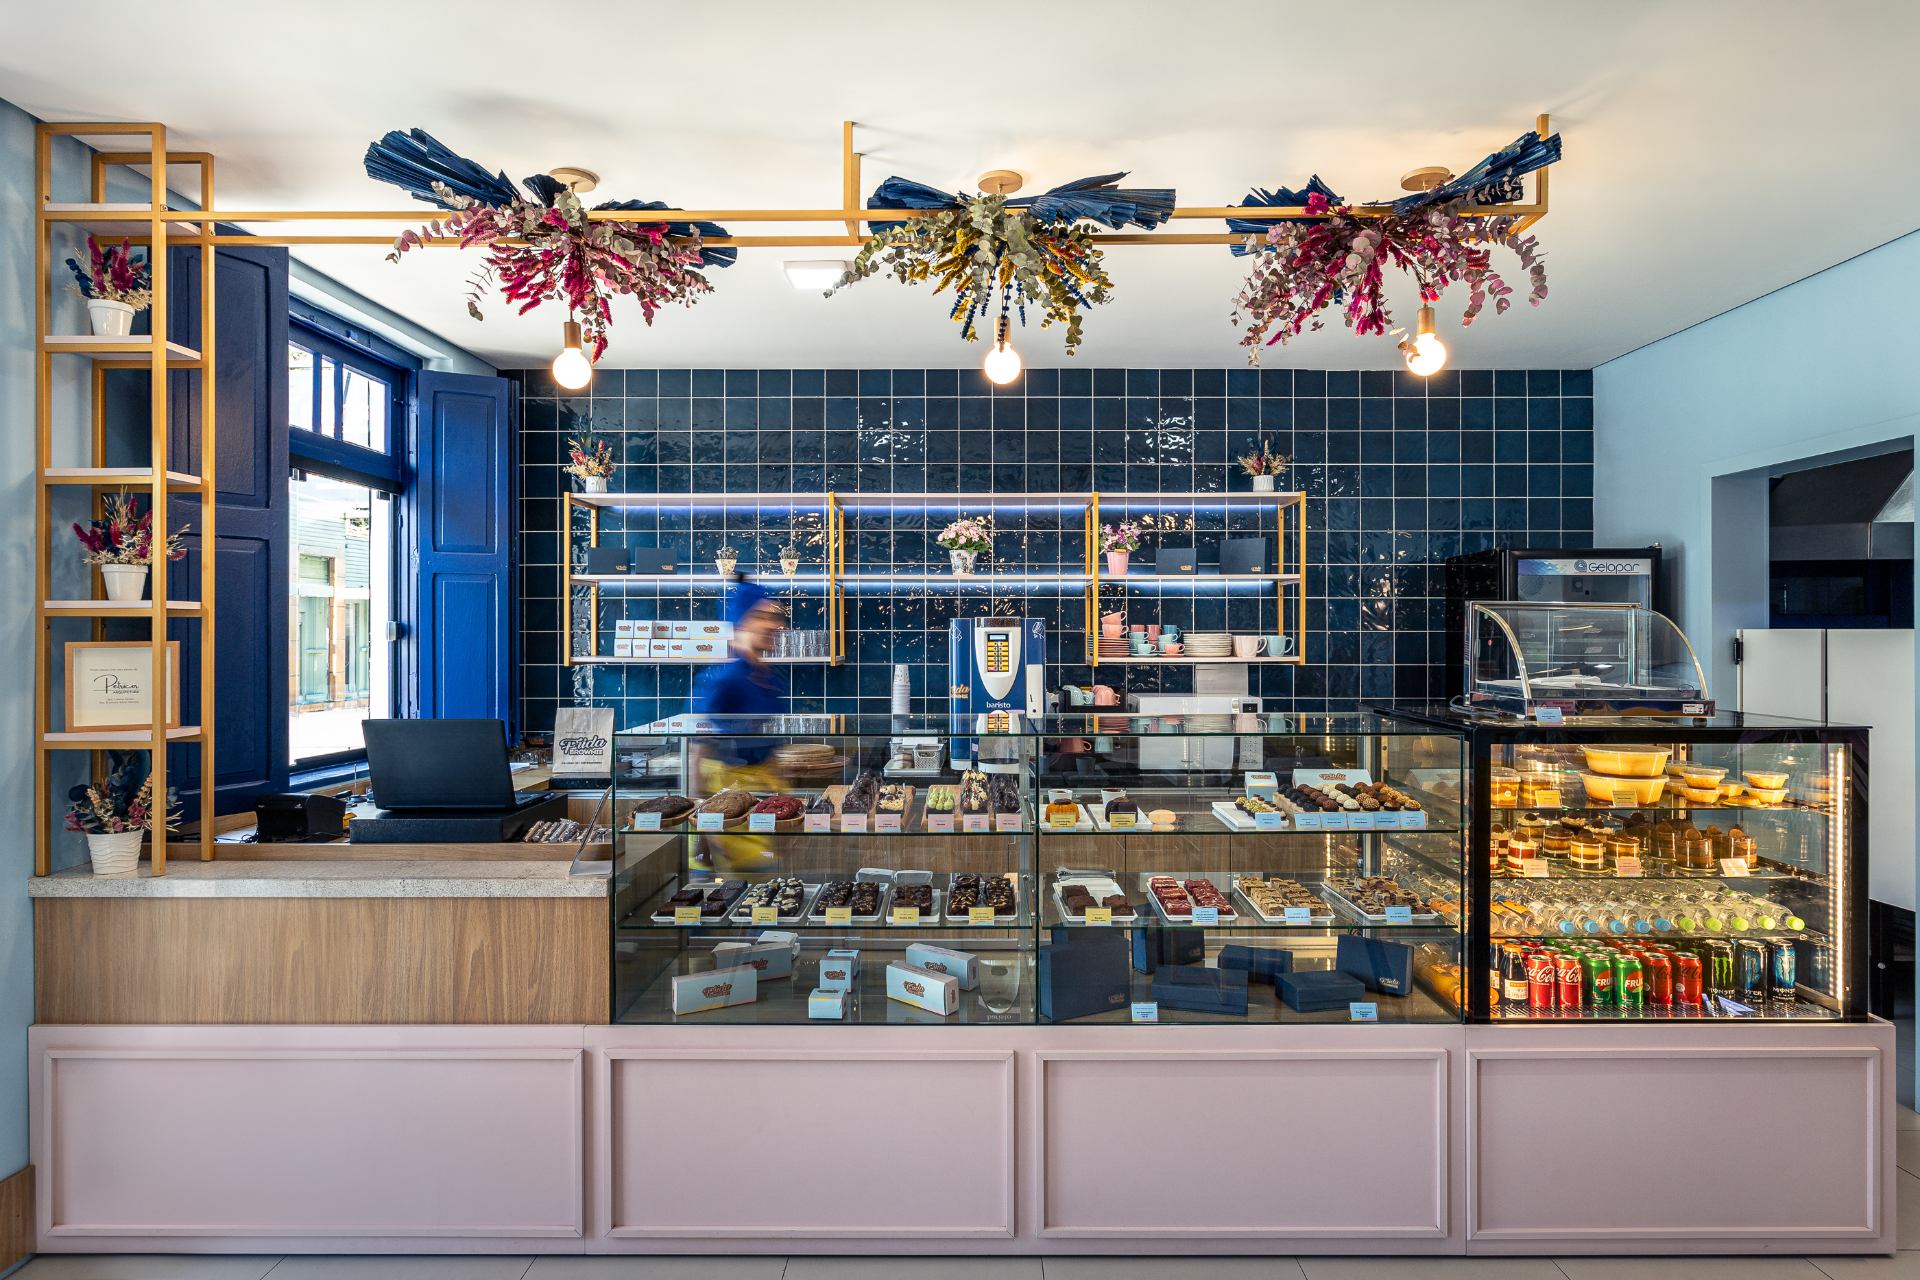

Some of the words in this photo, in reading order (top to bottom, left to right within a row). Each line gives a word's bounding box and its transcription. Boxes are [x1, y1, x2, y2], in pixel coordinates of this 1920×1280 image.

[1588, 562, 1640, 574] Gelopar
[986, 701, 1011, 709] baristo
[1595, 978, 1612, 987] FRU
[1625, 978, 1643, 987] FRU
